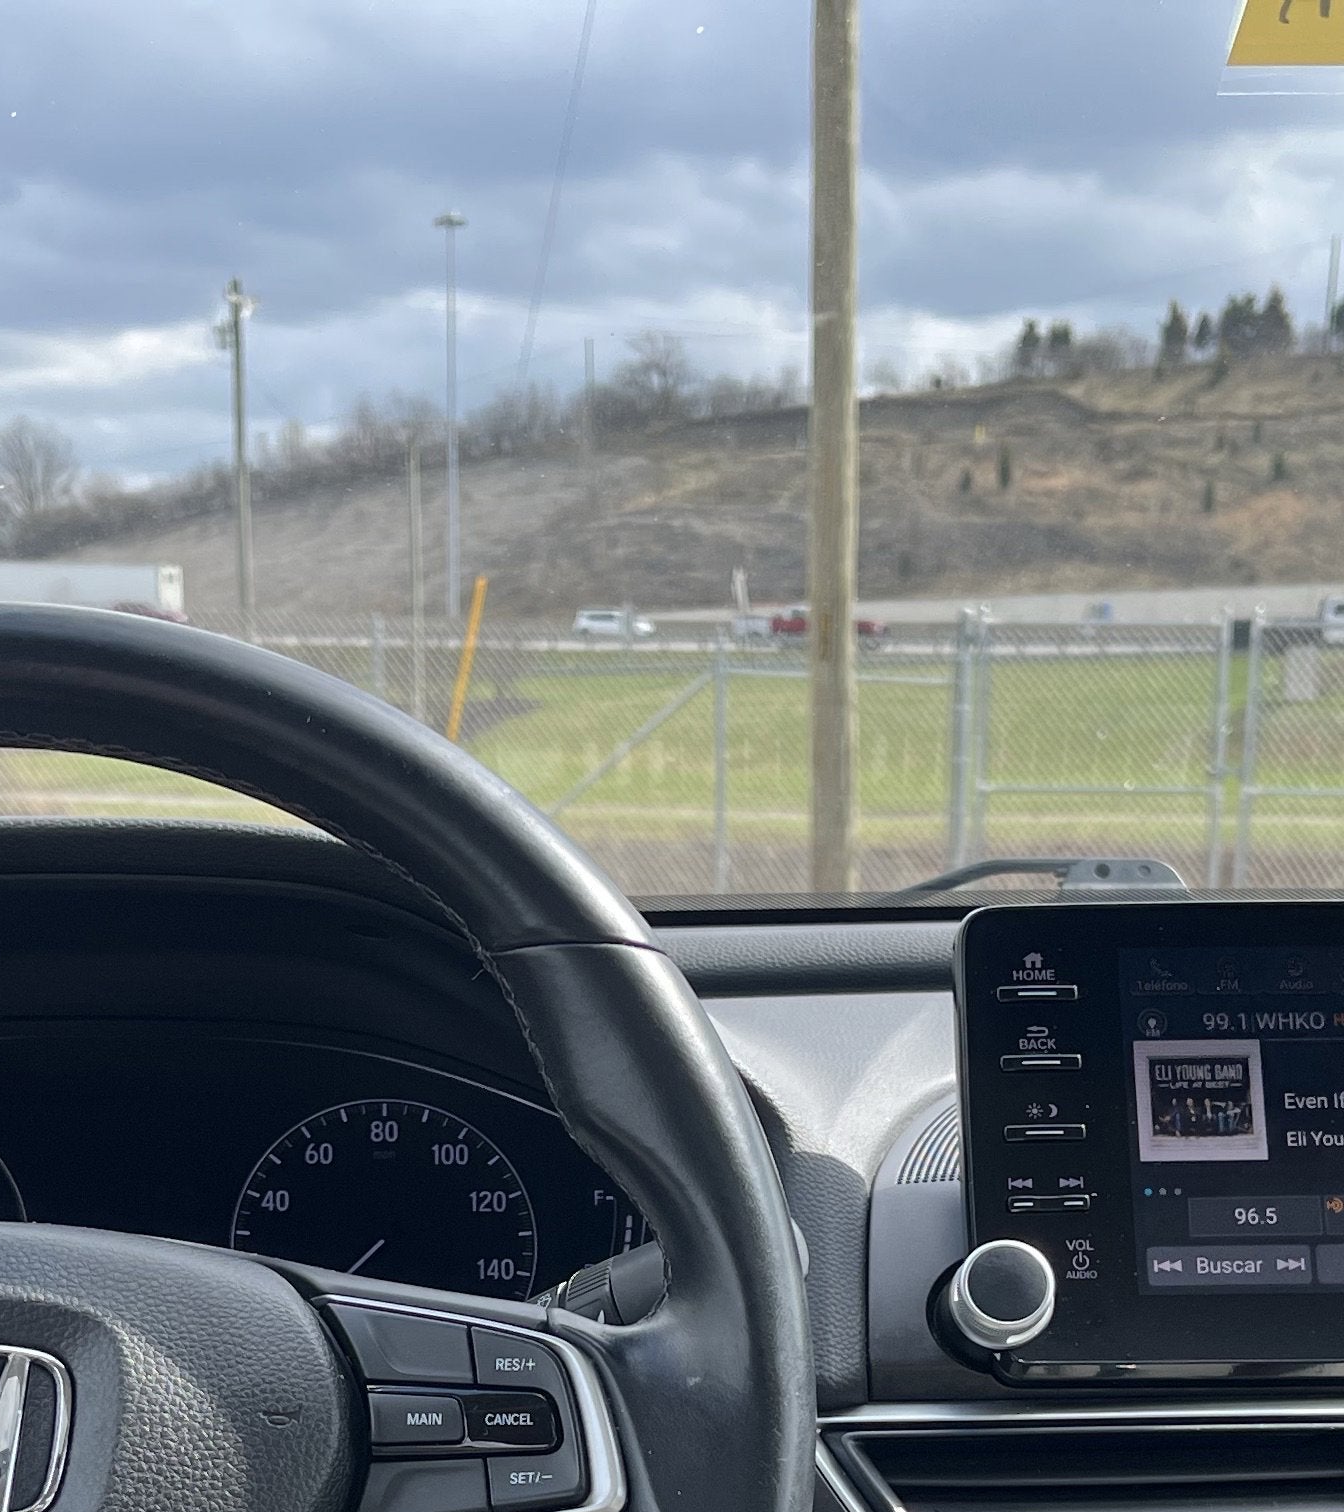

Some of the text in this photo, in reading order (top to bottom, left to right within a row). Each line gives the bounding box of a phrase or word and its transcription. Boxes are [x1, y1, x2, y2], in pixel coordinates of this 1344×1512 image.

[1012, 968, 1056, 982] HOME
[1279, 979, 1314, 991] Audio
[1202, 1011, 1248, 1032] 99.1
[1256, 1010, 1326, 1031] WHKO
[1018, 1037, 1057, 1051] BACK
[1155, 1063, 1243, 1081] ELI YOUNG BAND
[1283, 1092, 1328, 1110] Even
[369, 1121, 399, 1143] 80
[1286, 1129, 1307, 1147] Eli
[304, 1143, 334, 1166] 60
[431, 1144, 469, 1166] 100
[261, 1191, 290, 1212] 40
[469, 1191, 507, 1213] 120
[593, 1189, 605, 1206] F
[1233, 1207, 1278, 1226] 96.5
[1065, 1239, 1095, 1252] VOL
[477, 1259, 515, 1281] 140
[1065, 1268, 1098, 1280] AUDIO
[1196, 1256, 1263, 1275] Buscar
[406, 1412, 443, 1426] MAIN
[484, 1412, 534, 1426] CANCEL
